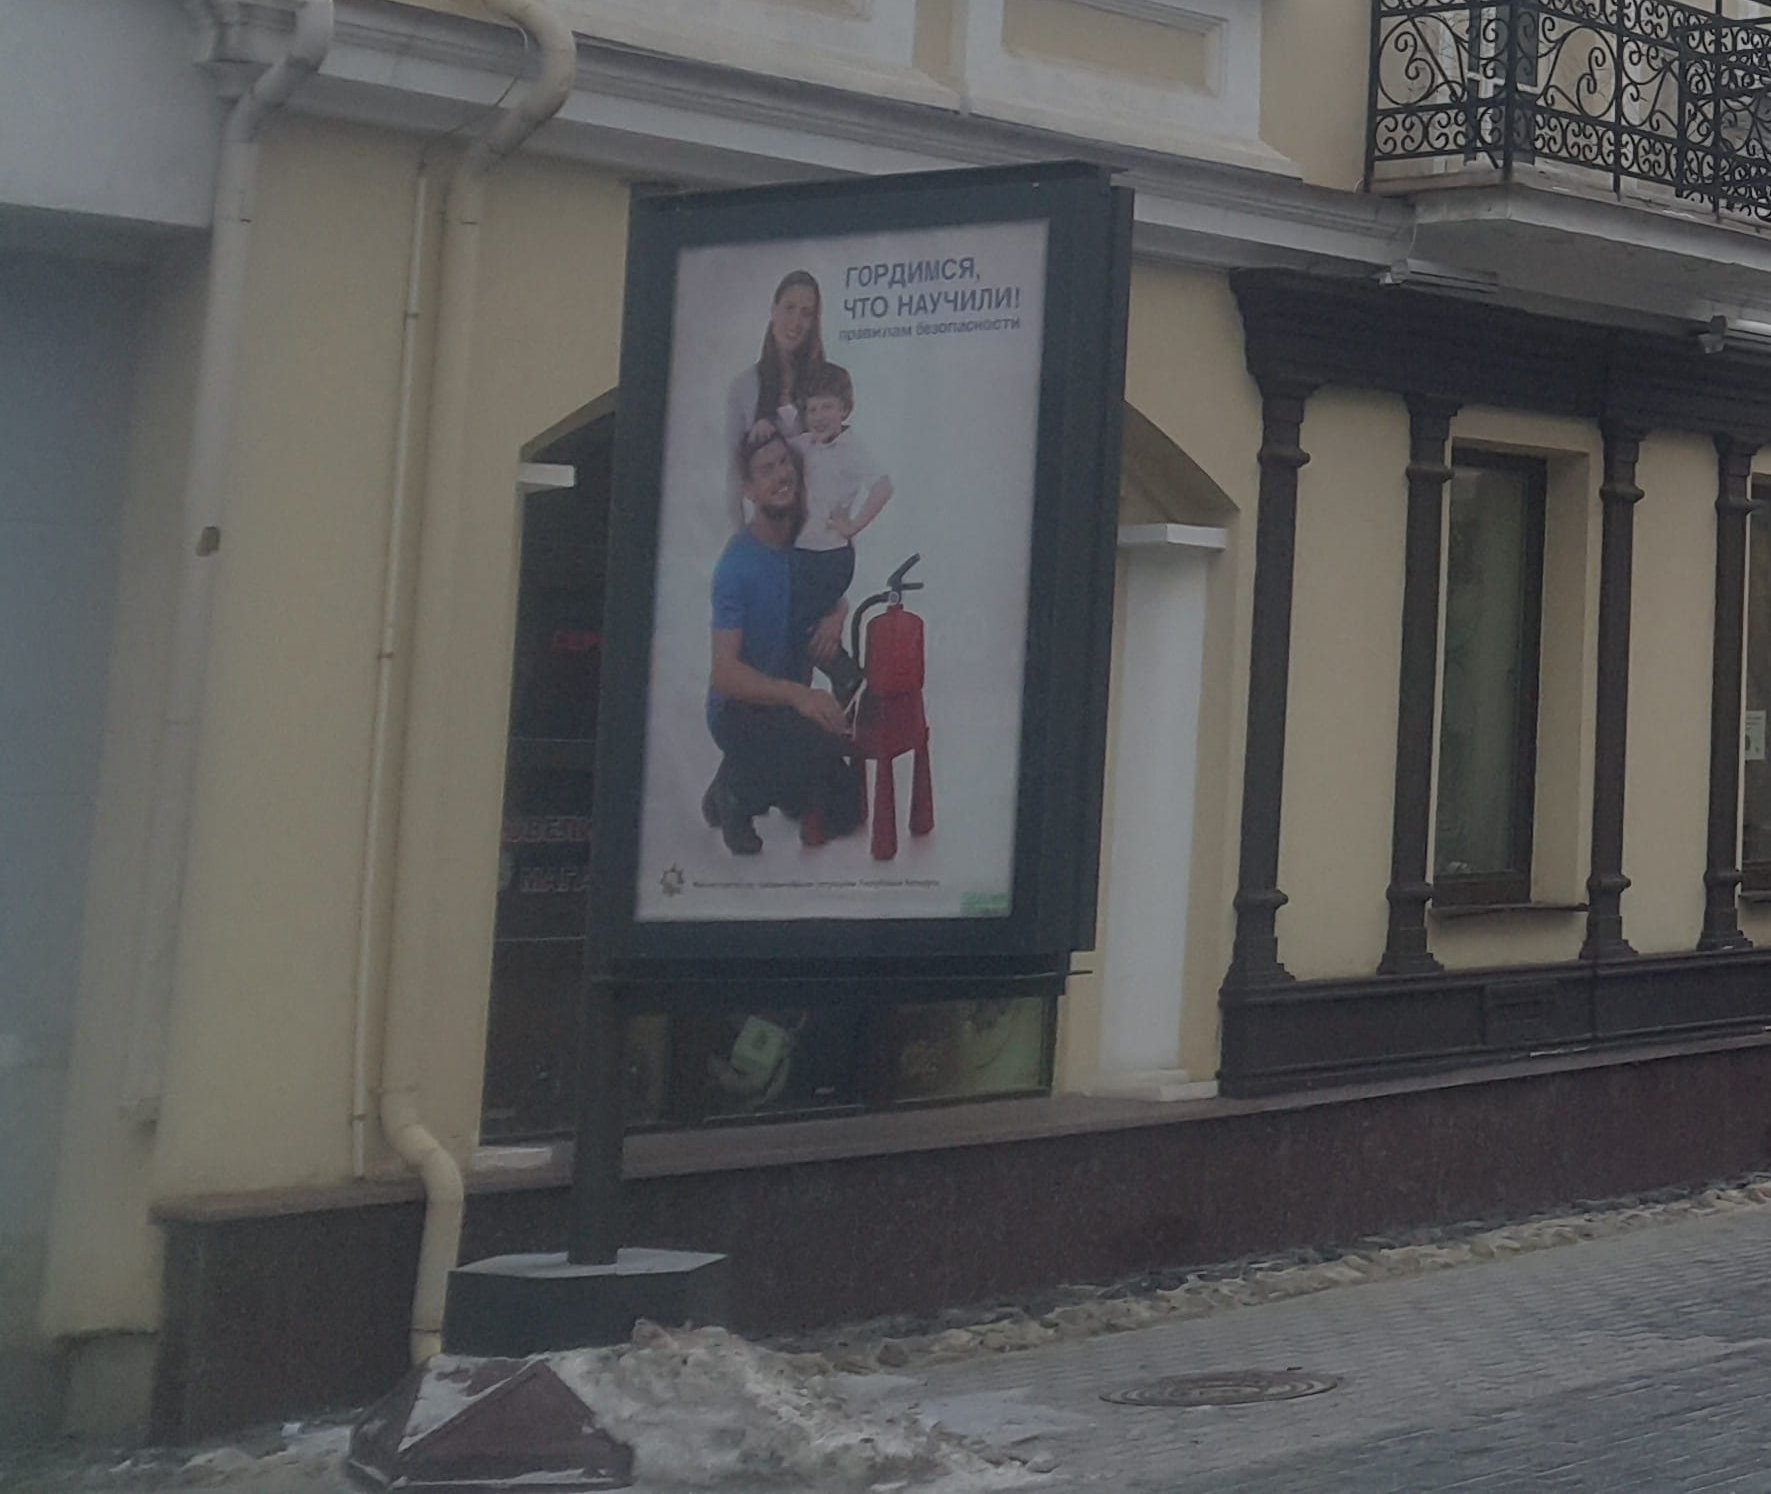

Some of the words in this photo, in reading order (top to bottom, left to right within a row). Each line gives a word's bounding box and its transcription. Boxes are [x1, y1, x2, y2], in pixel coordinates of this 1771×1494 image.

[845, 257, 981, 289] ГОРДИМСЯ,
[843, 296, 889, 320] ЧТО
[896, 286, 1021, 317] НАУЧИЛИ!
[838, 326, 912, 342] правилам
[915, 317, 1022, 337] безопасности
